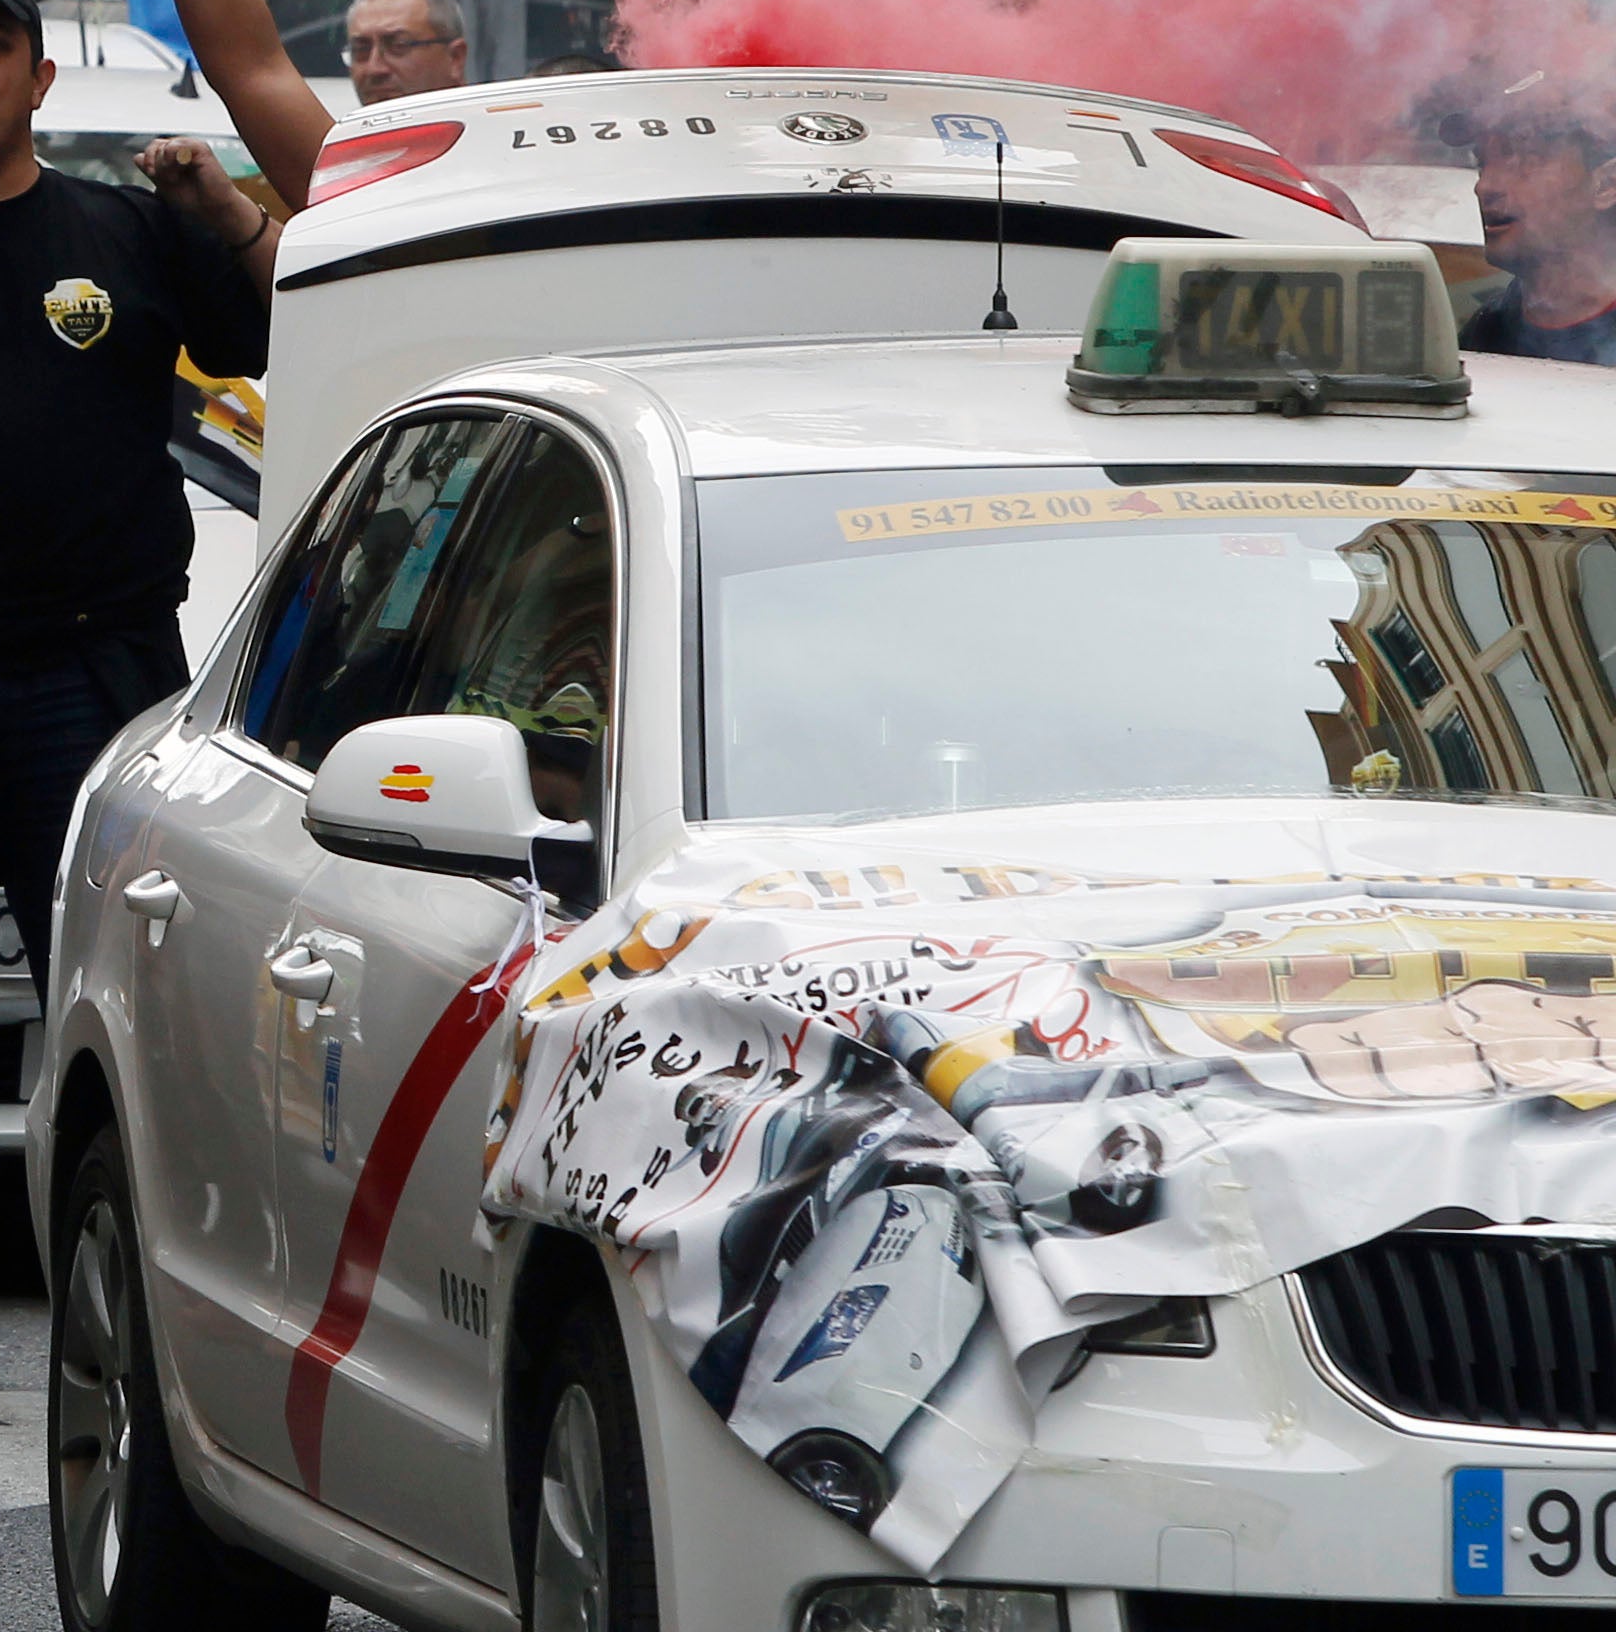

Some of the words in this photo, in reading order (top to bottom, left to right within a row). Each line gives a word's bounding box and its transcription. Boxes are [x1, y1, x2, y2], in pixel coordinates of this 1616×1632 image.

[512, 115, 717, 151] 08267
[43, 297, 113, 318] ELITE
[67, 316, 96, 326] TAXI
[1184, 282, 1338, 359] TAXI
[850, 512, 896, 536] 91
[911, 502, 975, 530] 547
[988, 499, 1037, 522] 82
[1046, 495, 1093, 518] 00
[1173, 487, 1521, 517] Radioteléfono-Taxi
[439, 1266, 488, 1340] 08267
[1467, 1542, 1489, 1569] E
